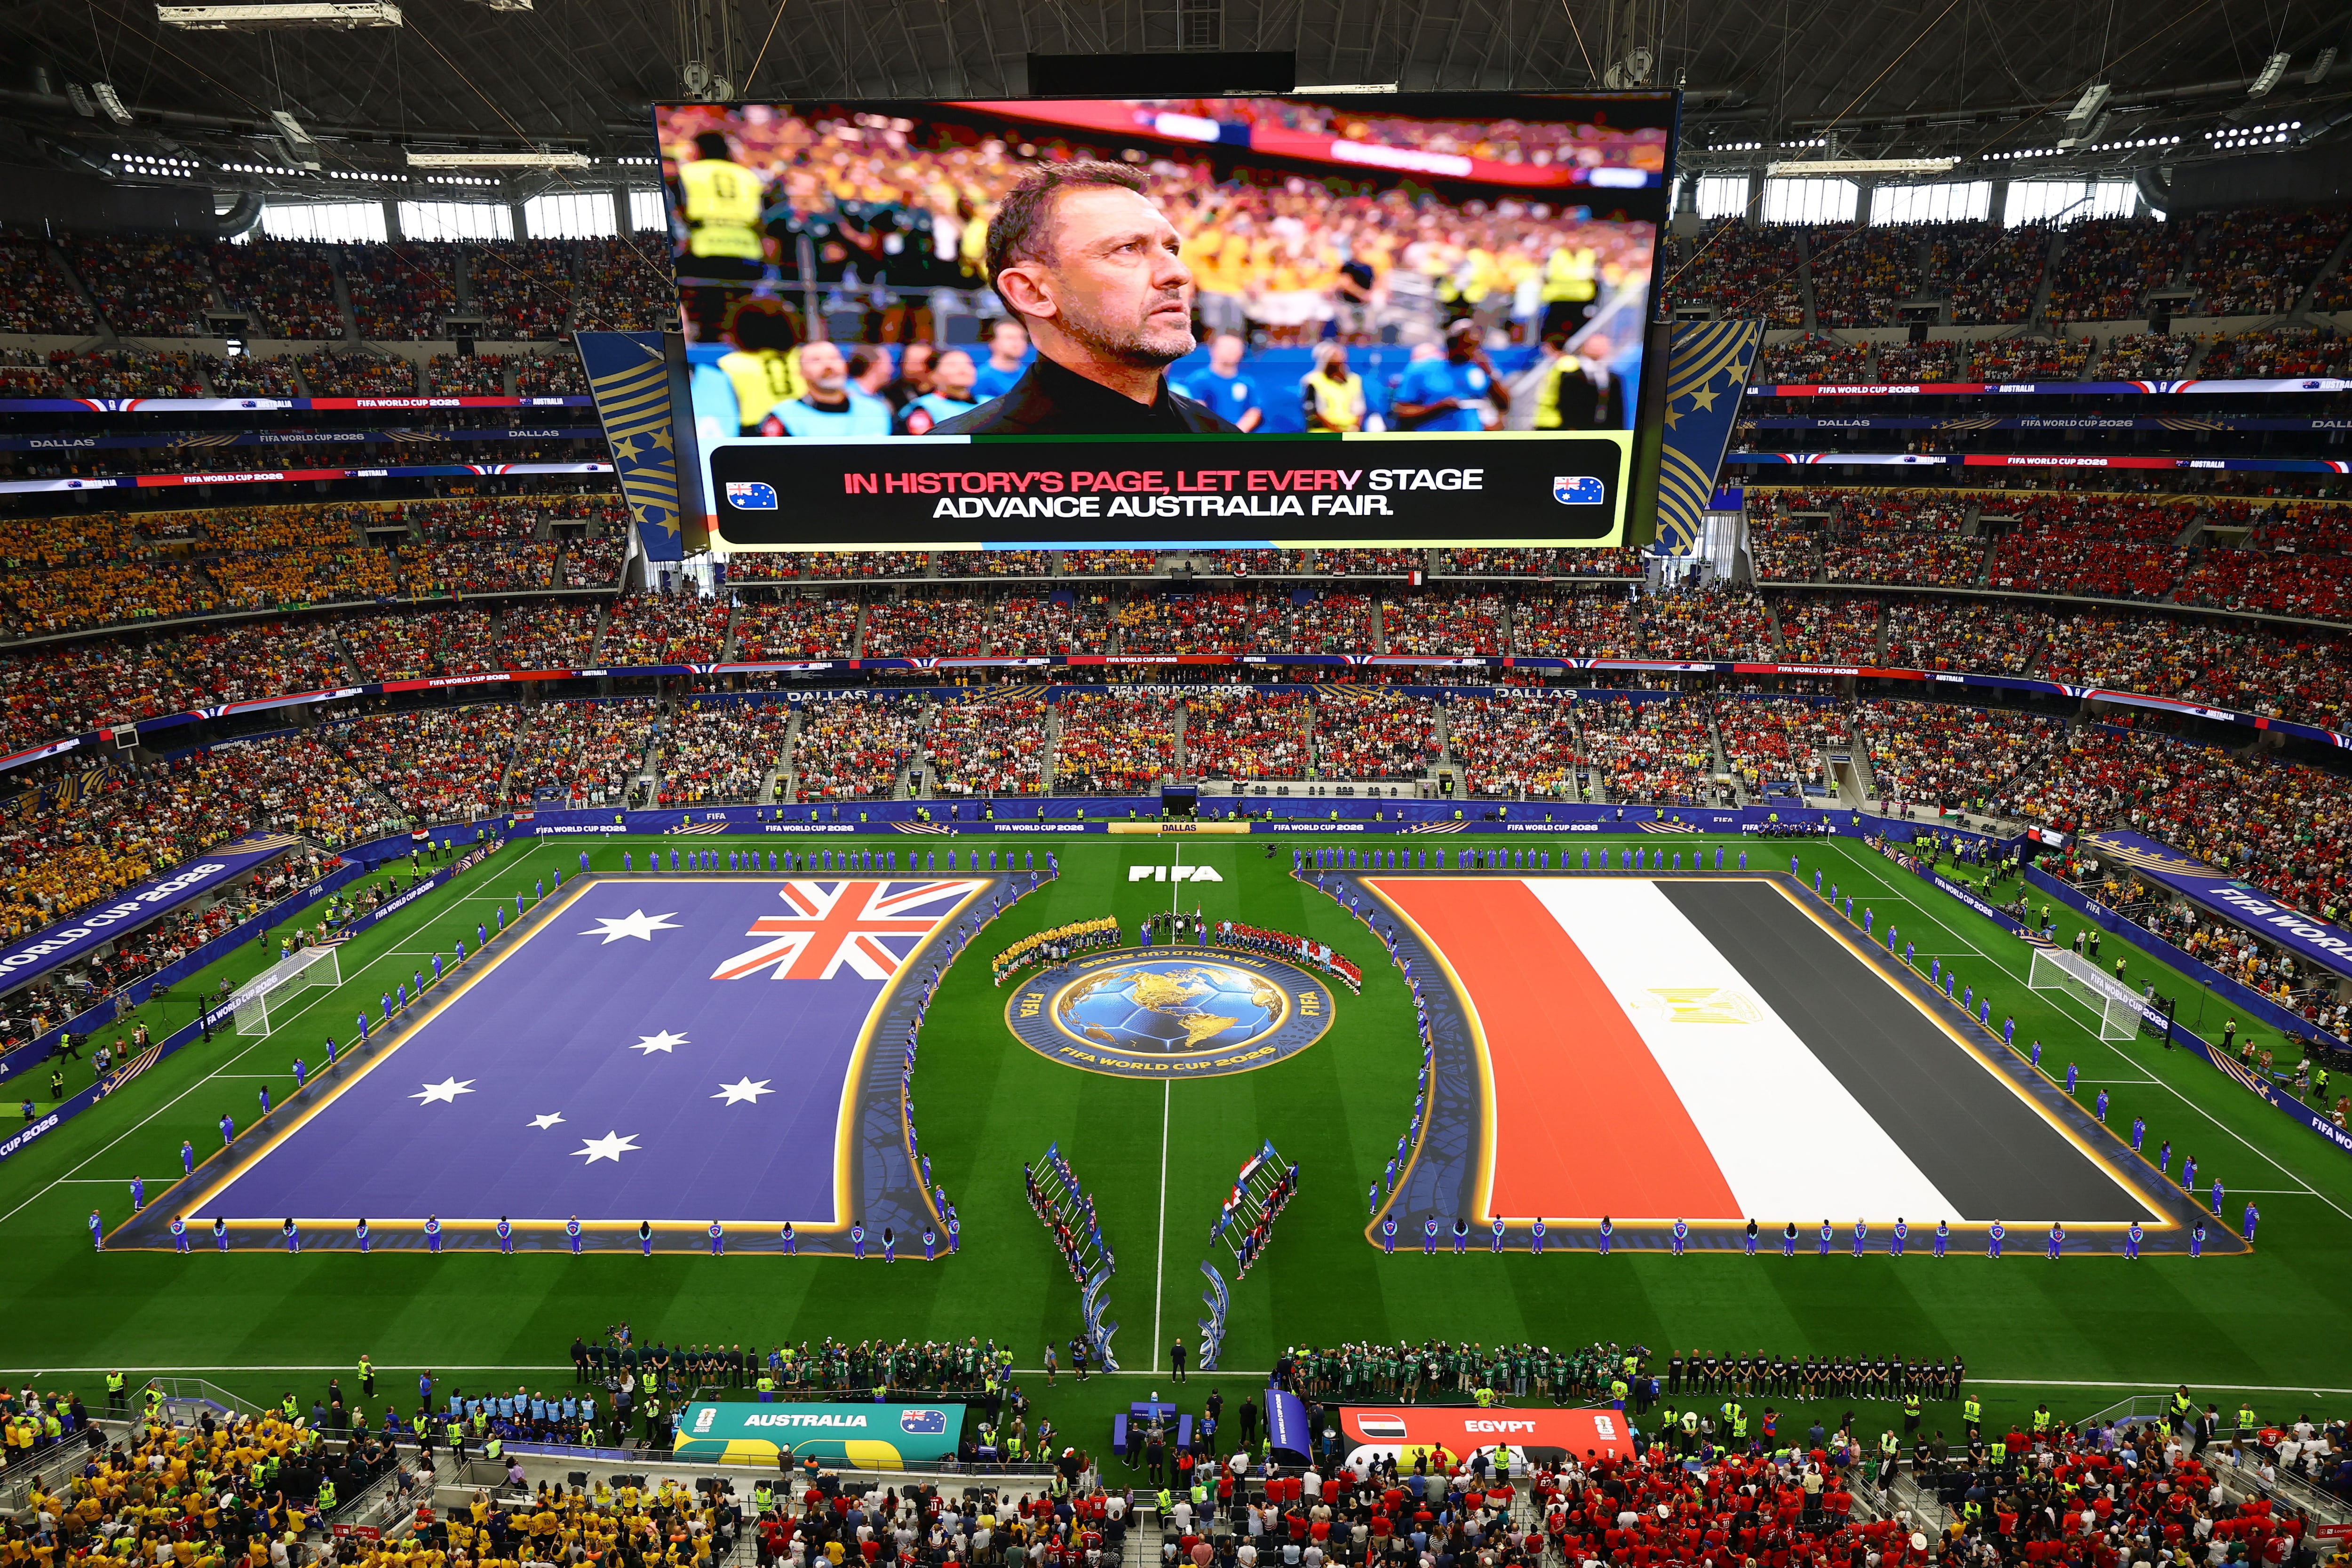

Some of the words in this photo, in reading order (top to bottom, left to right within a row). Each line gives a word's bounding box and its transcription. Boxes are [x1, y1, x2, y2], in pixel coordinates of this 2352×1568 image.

[256, 400, 292, 408] AUSTRALIA
[30, 439, 95, 448] DALLAS
[82, 479, 117, 487] AUSTRALIA
[844, 472, 878, 494] IN
[886, 471, 1064, 493] HISTORY'S
[1072, 470, 1170, 494] PAGE,
[1176, 471, 1240, 491] LET
[1247, 470, 1362, 491] EVERY
[1368, 469, 1483, 490] STAGE
[932, 496, 1100, 518] ADVANCE
[1107, 495, 1304, 517] AUSTRALIA
[1311, 494, 1394, 516] FAIR.
[787, 691, 868, 701] DALLAS
[1108, 685, 1130, 695] FIFA
[1209, 685, 1253, 695] 2026
[1495, 688, 1577, 699] DALLAS
[2206, 709, 2234, 721] AUSTRALIA
[56, 738, 80, 750] AUSTRALIA
[1128, 866, 1223, 882] FIFA
[83, 902, 142, 927] CUP
[139, 863, 226, 902] 2026
[309, 884, 323, 898] FIFA
[1935, 876, 1947, 889] FIFA
[1946, 883, 1963, 903] WORLD
[1963, 894, 1974, 908] CUP
[1974, 900, 1993, 917] 2026
[375, 909, 388, 921] FIFA
[387, 899, 406, 915] WORLD
[406, 891, 416, 902] CUP
[417, 880, 434, 896] 2026
[2086, 900, 2100, 915] FIFA
[2209, 889, 2278, 915] FIFA
[2266, 915, 2352, 961] WORL
[1079, 953, 1134, 969] 2026
[1172, 950, 1230, 960] WORLD
[1234, 955, 1267, 968] FIFA
[200, 1014, 217, 1030] FFA
[216, 998, 241, 1019] WORLD
[241, 988, 255, 1003] CUP
[254, 974, 278, 992] 2026
[1020, 993, 1045, 1018] FIFA
[1300, 991, 1319, 1016] FIFA
[2090, 973, 2105, 989] FIFA
[2104, 984, 2129, 1003] WORLD
[2128, 999, 2143, 1012] CUP
[2142, 1007, 2169, 1030] 2026
[1059, 1046, 1098, 1061] FIFA
[1100, 1056, 1168, 1071] WORLD
[1172, 1061, 1212, 1071] CUP
[1215, 1045, 1276, 1067] 2026
[0, 1137, 22, 1156] CUP
[22, 1114, 59, 1143] 2026
[2312, 1116, 2334, 1139] FIFA
[744, 1415, 867, 1427] AUSTRALIA
[1464, 1420, 1536, 1433] EGYPT
[931, 1502, 938, 1511] 11
